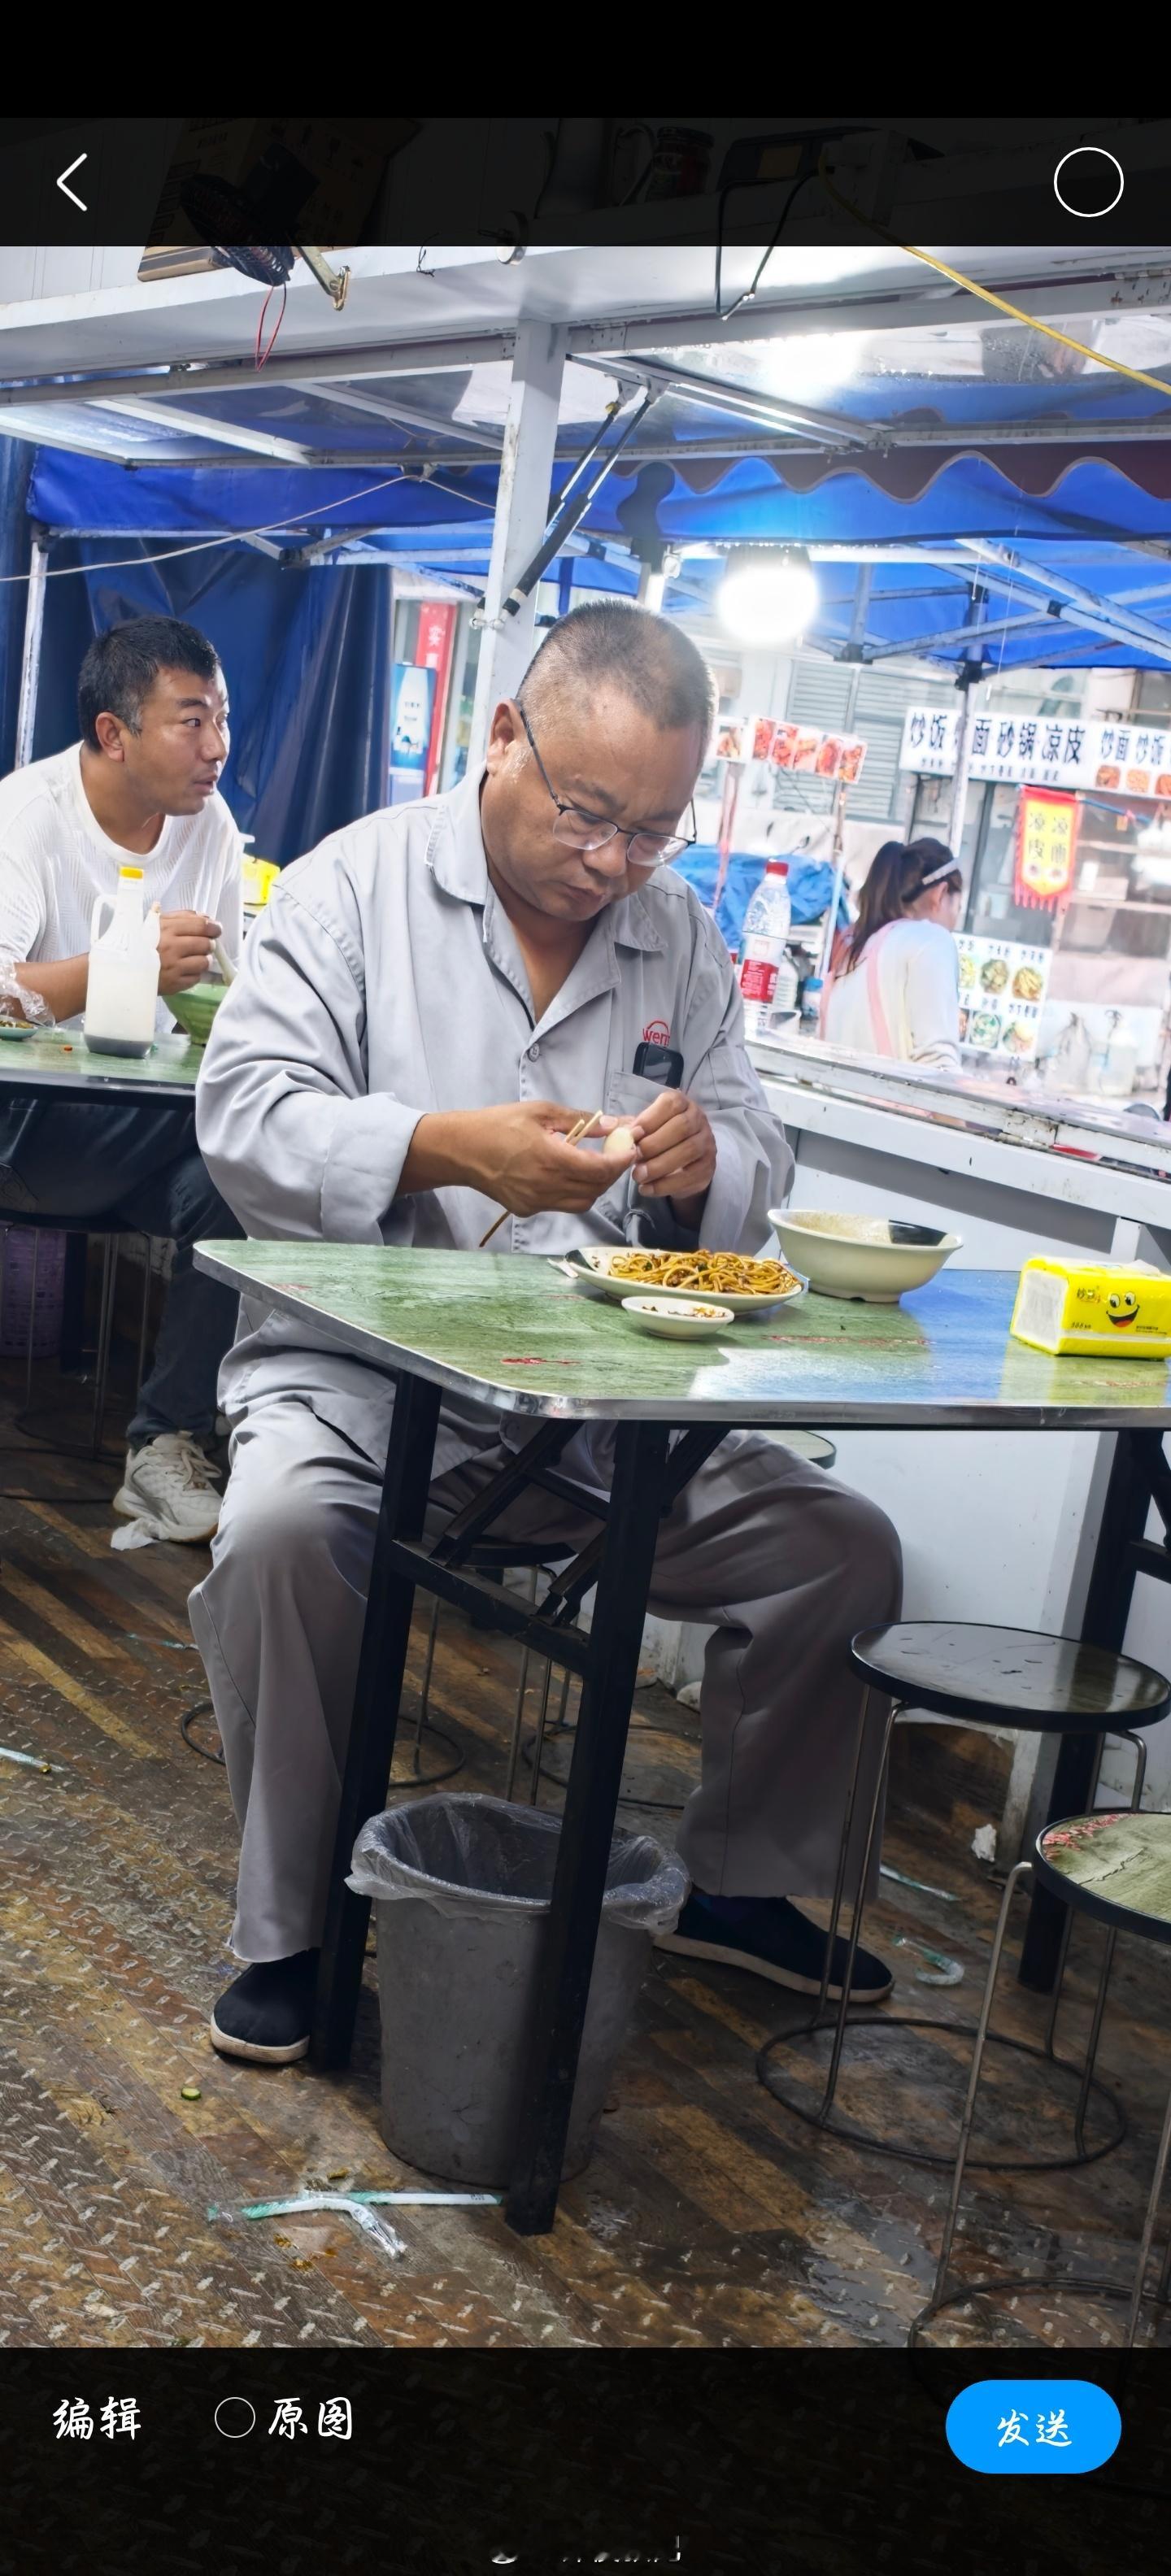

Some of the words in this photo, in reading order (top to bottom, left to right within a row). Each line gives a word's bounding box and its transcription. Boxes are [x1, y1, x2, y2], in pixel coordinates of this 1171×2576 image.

[910, 713, 1086, 764] 炒饭面砂锅凉皮
